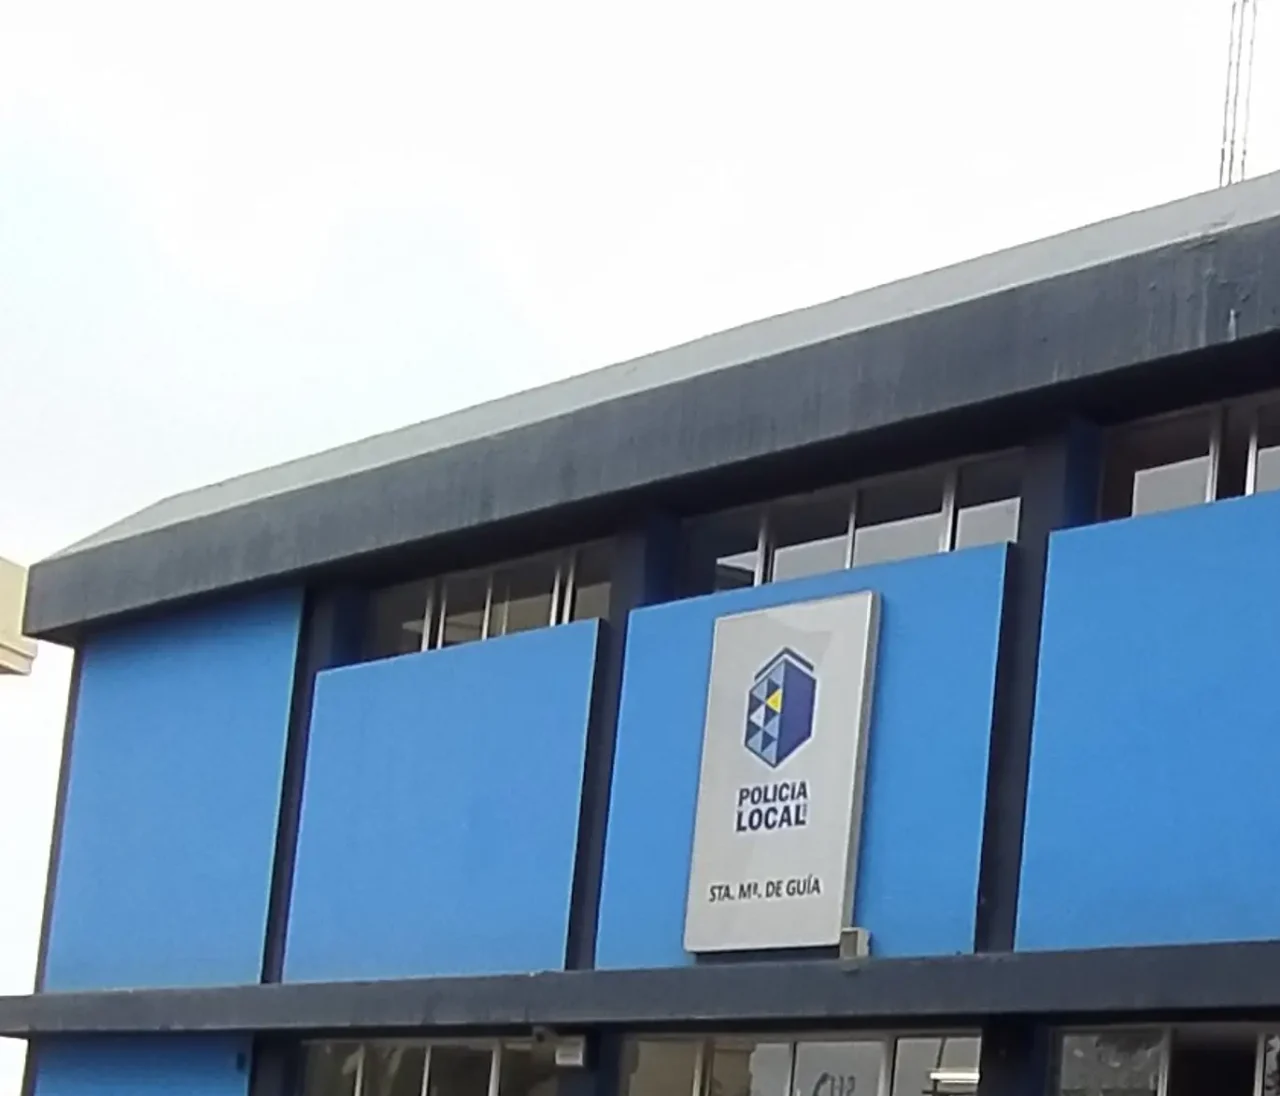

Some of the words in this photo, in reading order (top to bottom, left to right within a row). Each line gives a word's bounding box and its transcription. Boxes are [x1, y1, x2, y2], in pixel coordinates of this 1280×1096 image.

[736, 804, 806, 832] LOCAL
[708, 883, 736, 903] STA.
[765, 879, 783, 898] DE
[785, 873, 821, 896] GUÍA
